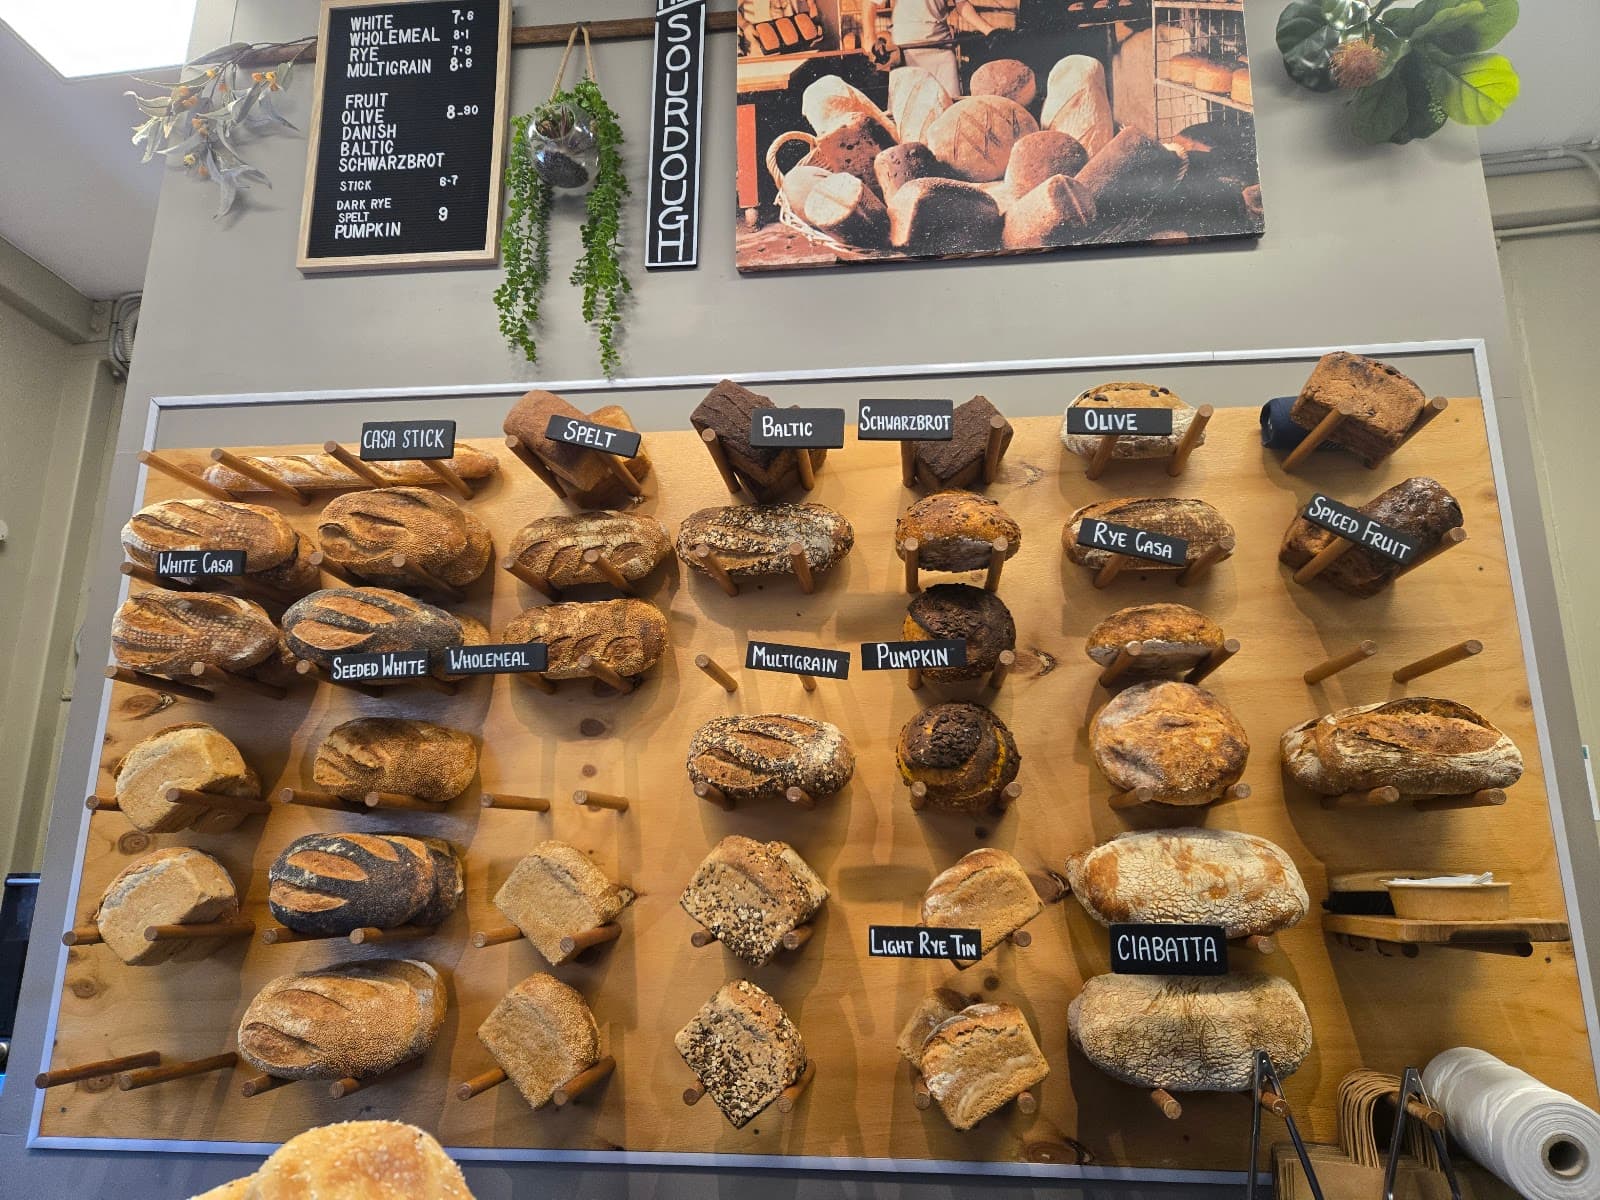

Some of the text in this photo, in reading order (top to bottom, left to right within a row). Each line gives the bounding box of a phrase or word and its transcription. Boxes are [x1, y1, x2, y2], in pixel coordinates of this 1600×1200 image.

[351, 14, 394, 31] WHITE
[349, 26, 441, 47] WHOLEMEAL
[350, 46, 379, 62] RYE
[347, 58, 431, 78] MULTIGRAIN
[345, 92, 389, 109] FRUIT
[341, 108, 385, 125] OLIVE
[342, 123, 397, 141] DANISH
[657, 13, 691, 263] SOURDOUGH
[340, 140, 394, 157] BALTIC
[338, 152, 446, 173] SCHWARZBROT
[339, 180, 372, 192] STICK
[336, 197, 392, 211] DARK RYE
[338, 206, 449, 223] SPELT 9
[334, 221, 401, 240] PUMPKIN
[762, 415, 813, 438] BALTIC
[859, 405, 951, 431] SCHWARZBROT
[1084, 409, 1138, 431] OLIVE
[363, 427, 444, 450] CASA STICK
[563, 420, 617, 449] SPELT
[1308, 495, 1411, 560] SPICED FRUIT
[1093, 522, 1173, 559] RYE CASA
[159, 552, 233, 574] WHITE CASA
[450, 649, 530, 670] WHOLEMEAL
[752, 645, 838, 674] MULTIGRAIN
[876, 643, 949, 669] PUMPKIN
[332, 653, 426, 681] SEEDED WHITE
[871, 928, 977, 957] LIGHT RYE TIN
[1117, 934, 1218, 962] CIABATTA
